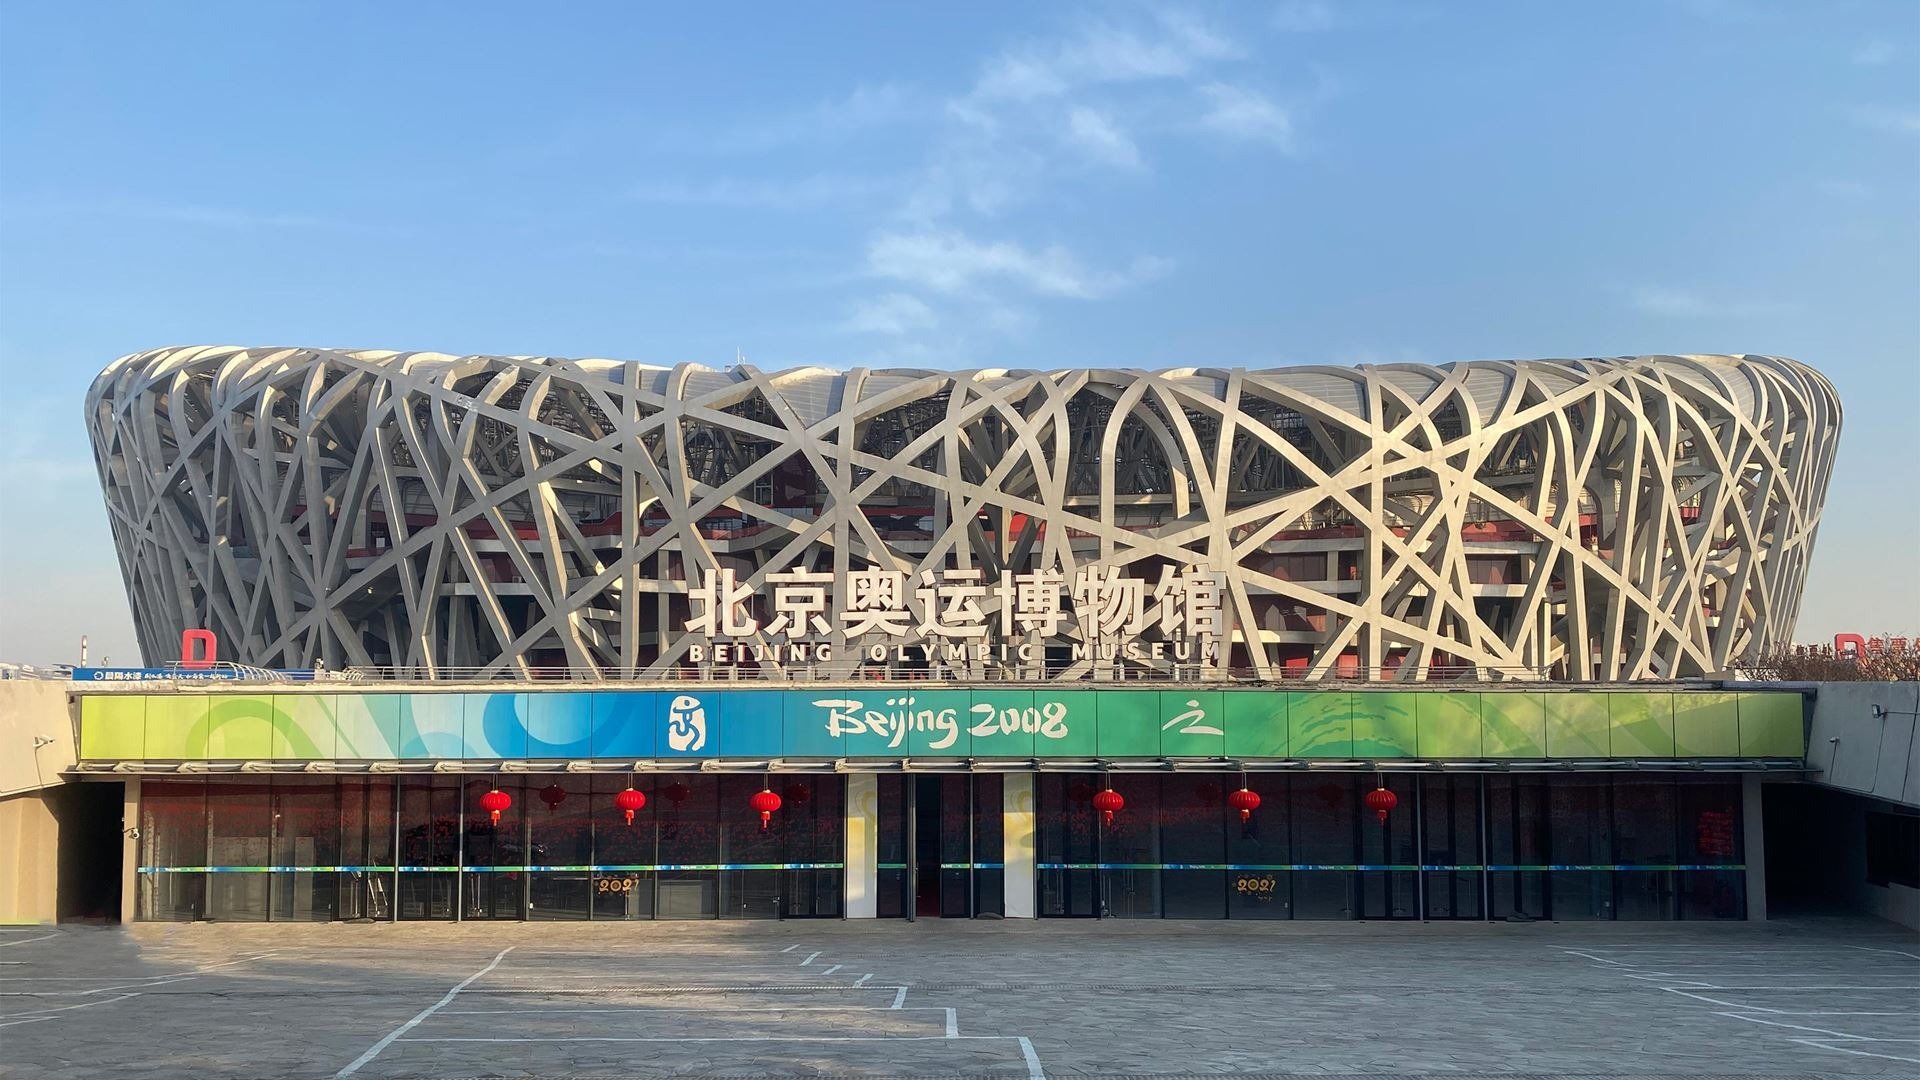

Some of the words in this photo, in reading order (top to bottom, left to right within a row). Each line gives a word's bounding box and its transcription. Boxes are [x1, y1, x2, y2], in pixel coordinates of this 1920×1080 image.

[684, 564, 1227, 638] 北京奥运博物馆
[182, 629, 218, 670] D
[689, 644, 832, 662] BEIJING
[870, 643, 1033, 662] OLYMPIC
[1072, 642, 1220, 661] MUSEUM
[812, 697, 959, 750] Beijing
[966, 702, 1069, 739] 2008
[598, 878, 640, 893] 2021
[1237, 878, 1277, 893] 2021
